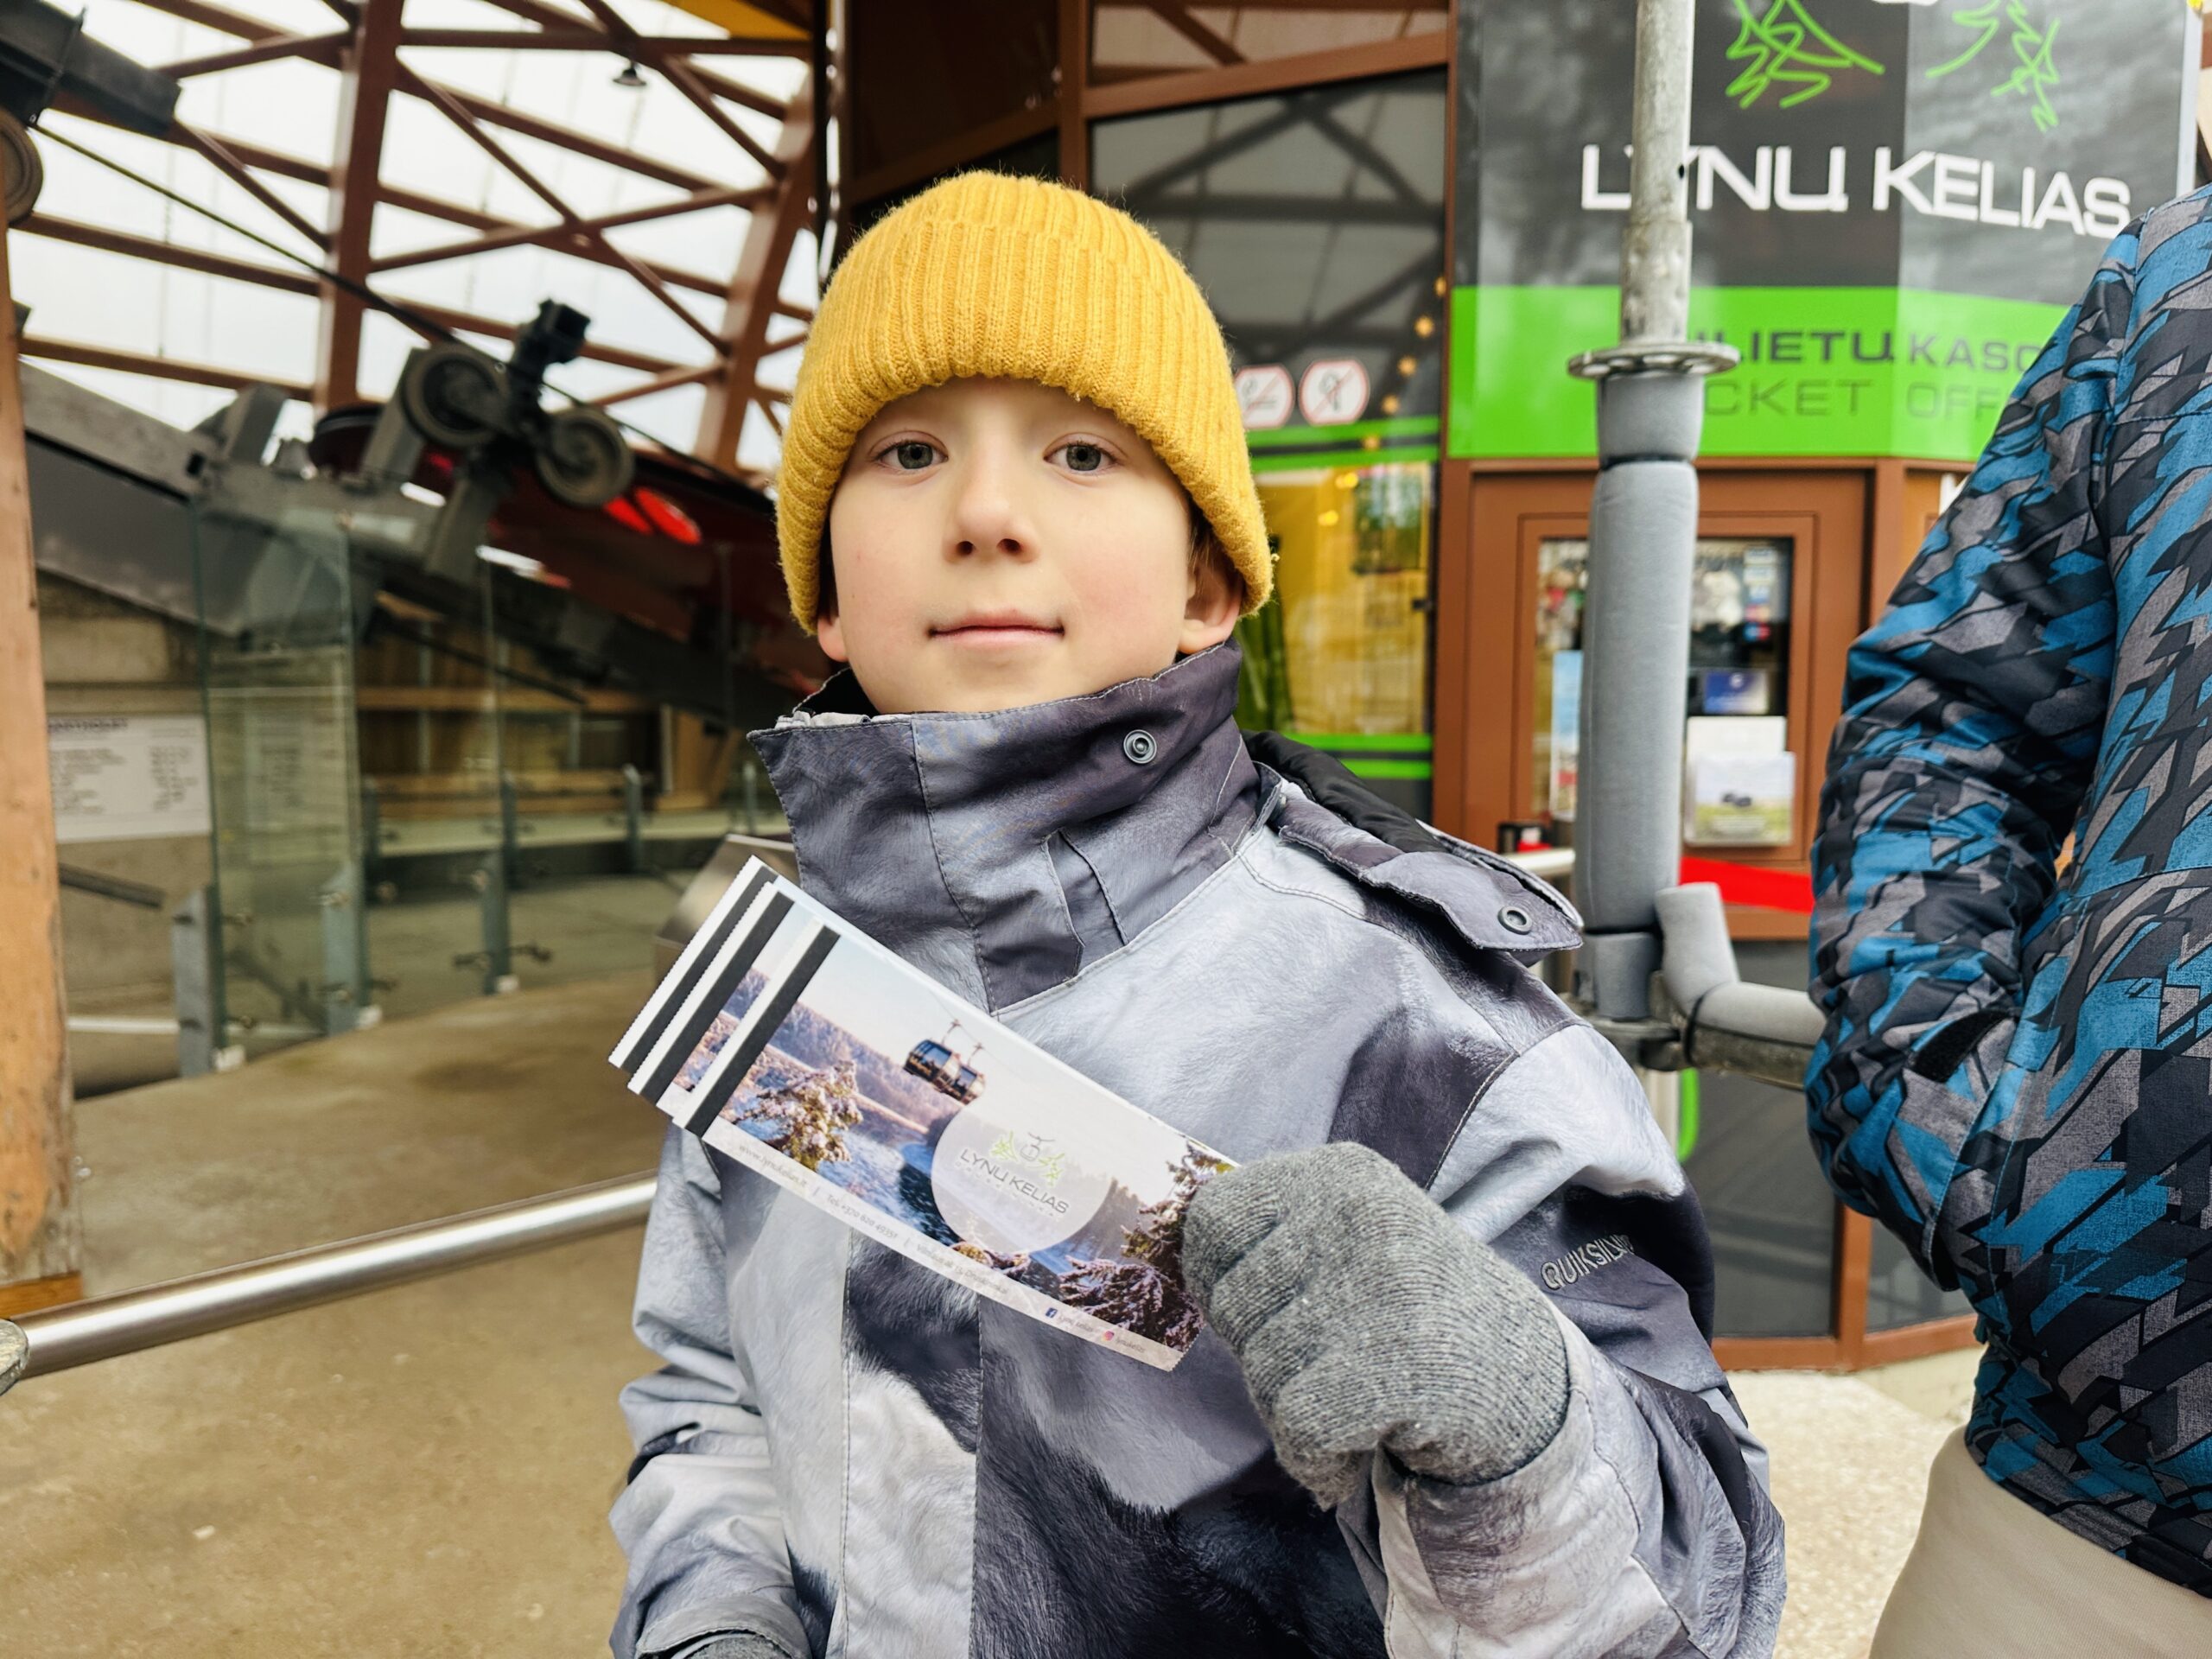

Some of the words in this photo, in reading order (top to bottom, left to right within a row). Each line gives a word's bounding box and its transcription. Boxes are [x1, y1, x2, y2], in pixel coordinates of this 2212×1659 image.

[1872, 146, 2131, 238] KELIAS
[1704, 379, 1872, 416] CKET
[1907, 381, 2001, 419] OFF
[1008, 1176, 1070, 1214] KELIAS
